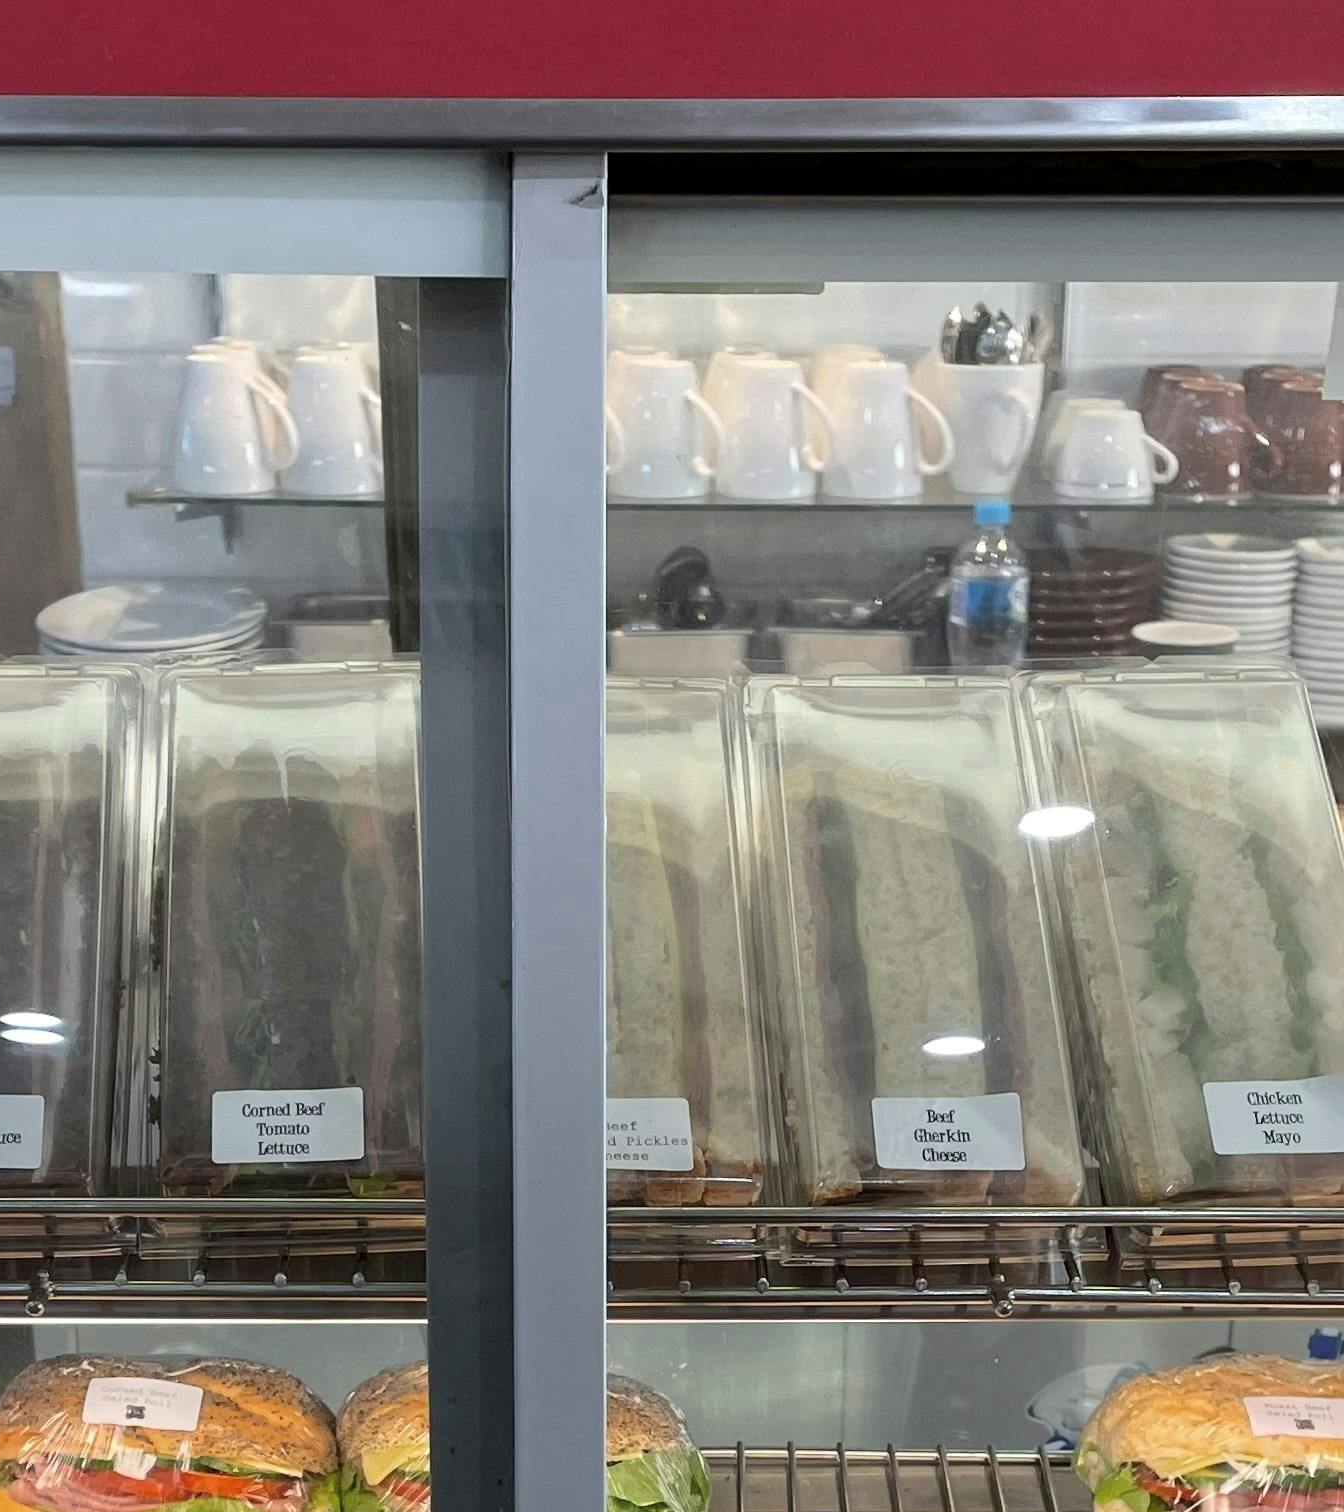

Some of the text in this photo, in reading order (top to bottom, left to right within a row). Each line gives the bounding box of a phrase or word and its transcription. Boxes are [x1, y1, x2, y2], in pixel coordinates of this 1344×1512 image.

[1247, 1092, 1303, 1105] Chicken
[242, 1103, 325, 1117] Corned Beef
[927, 1110, 956, 1123] Beef
[1254, 1111, 1303, 1125] Lettuce
[256, 1123, 310, 1136] Tomato
[914, 1129, 971, 1143] Gherkin
[627, 1136, 688, 1147] Pickles
[1264, 1130, 1301, 1145] Mayo
[257, 1142, 309, 1155] Lettuce
[922, 1148, 967, 1162] Cheese
